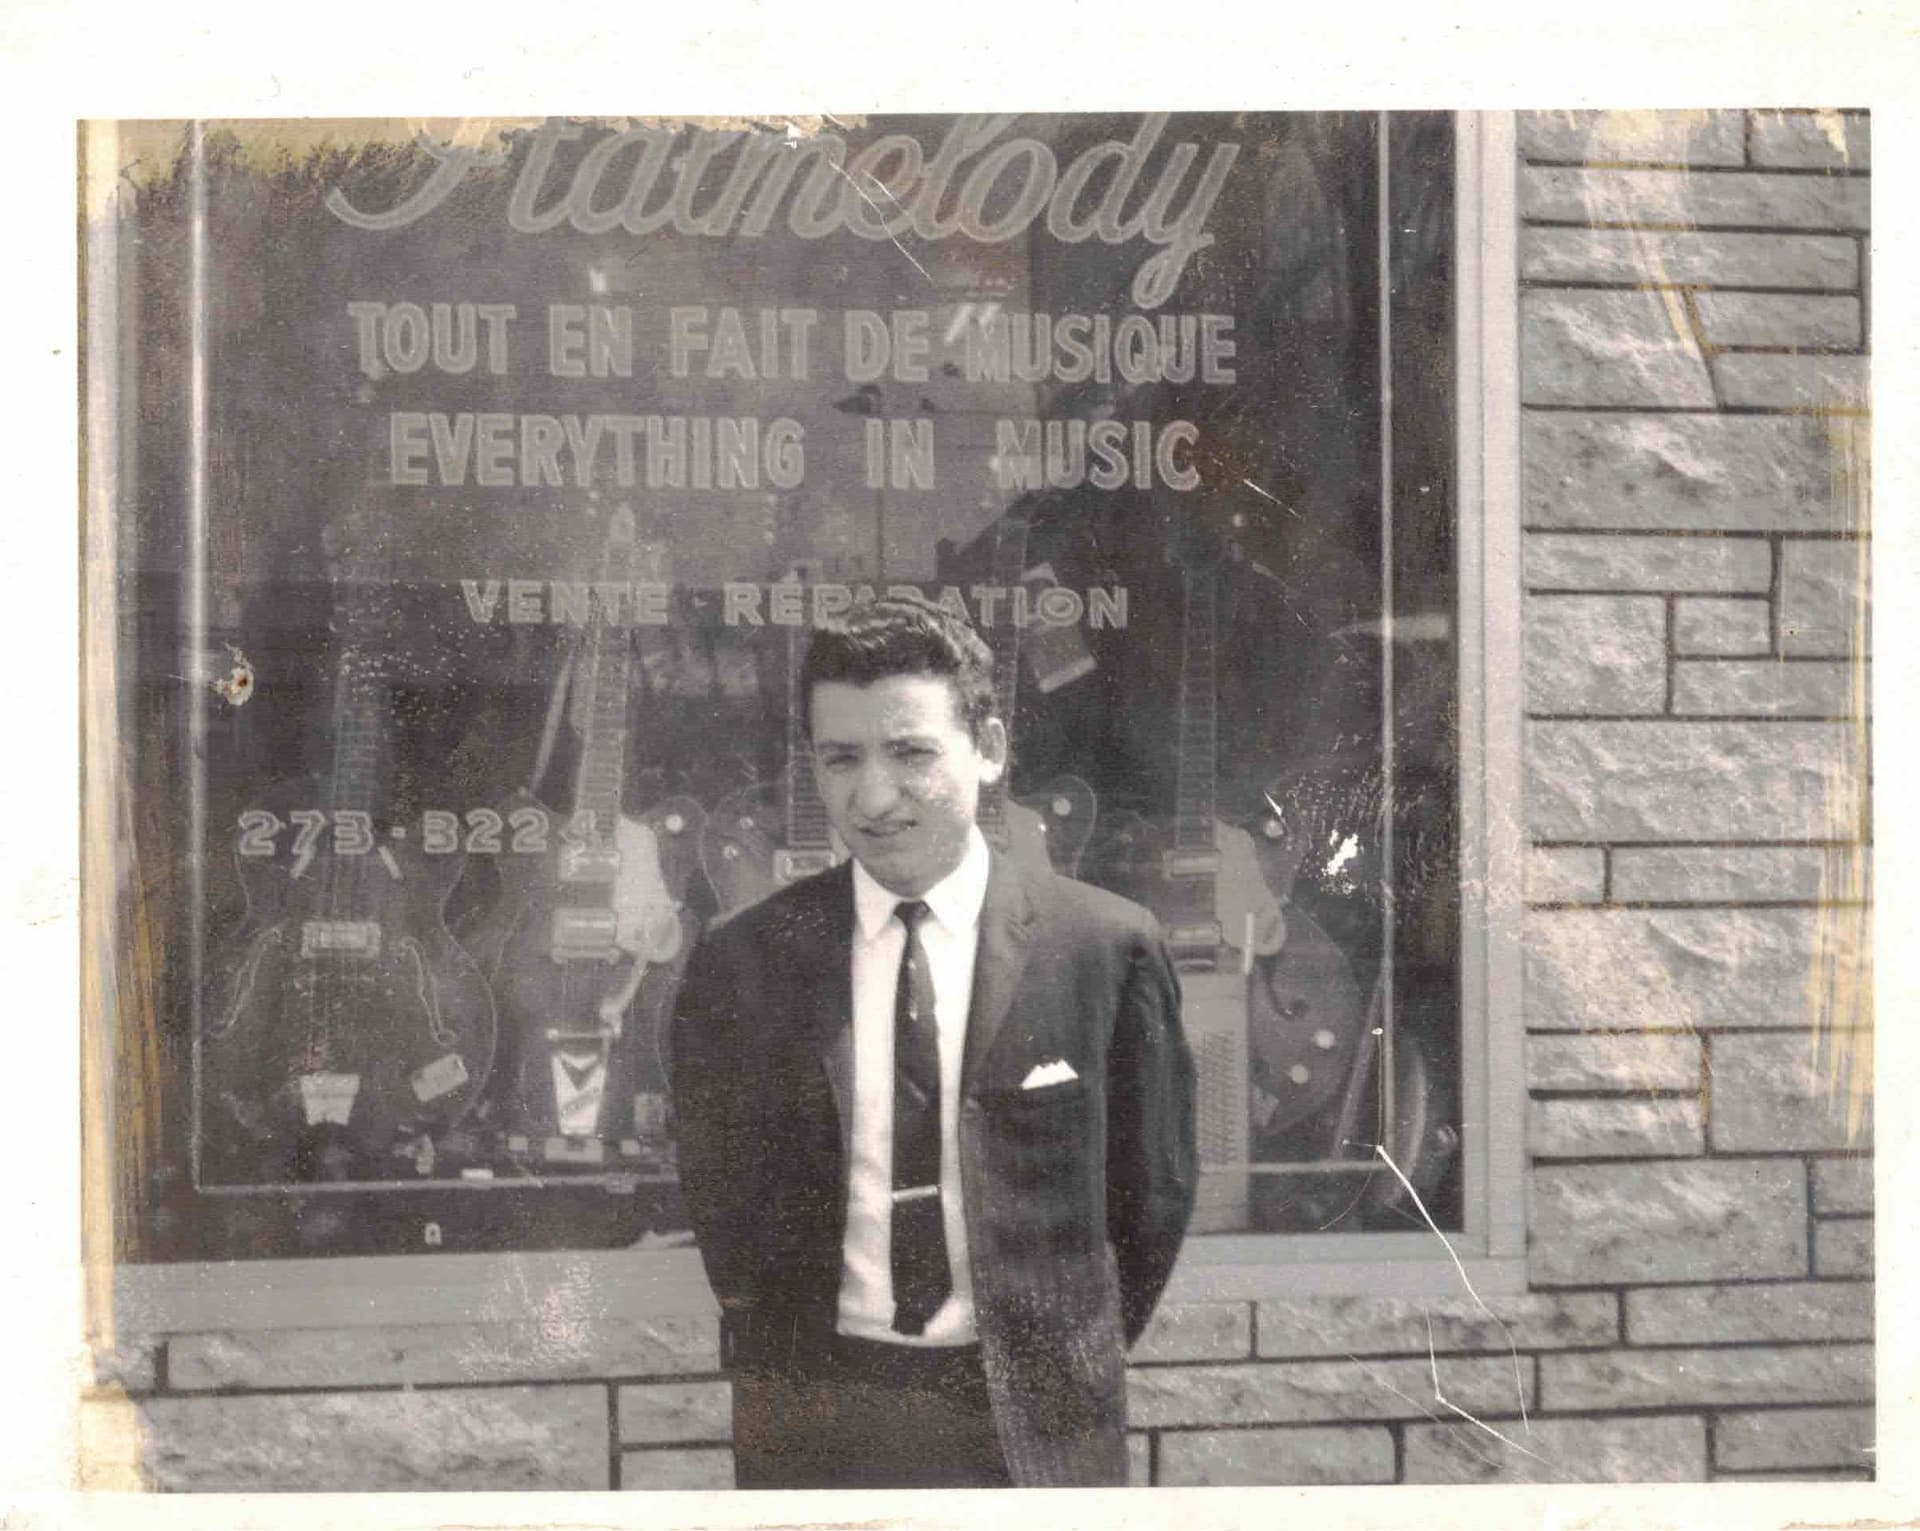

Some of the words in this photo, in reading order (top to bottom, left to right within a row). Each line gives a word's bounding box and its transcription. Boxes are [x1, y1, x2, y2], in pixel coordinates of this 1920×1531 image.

[347, 302, 516, 377] TOUT
[549, 304, 633, 377] EN
[670, 306, 817, 380] FAIT
[843, 310, 930, 382] DE
[966, 312, 1238, 385] MUSIQUE
[390, 411, 805, 490] EVERYTHING
[866, 417, 936, 490] IN
[996, 418, 1201, 492] MUSIC
[459, 579, 669, 627] VENTE
